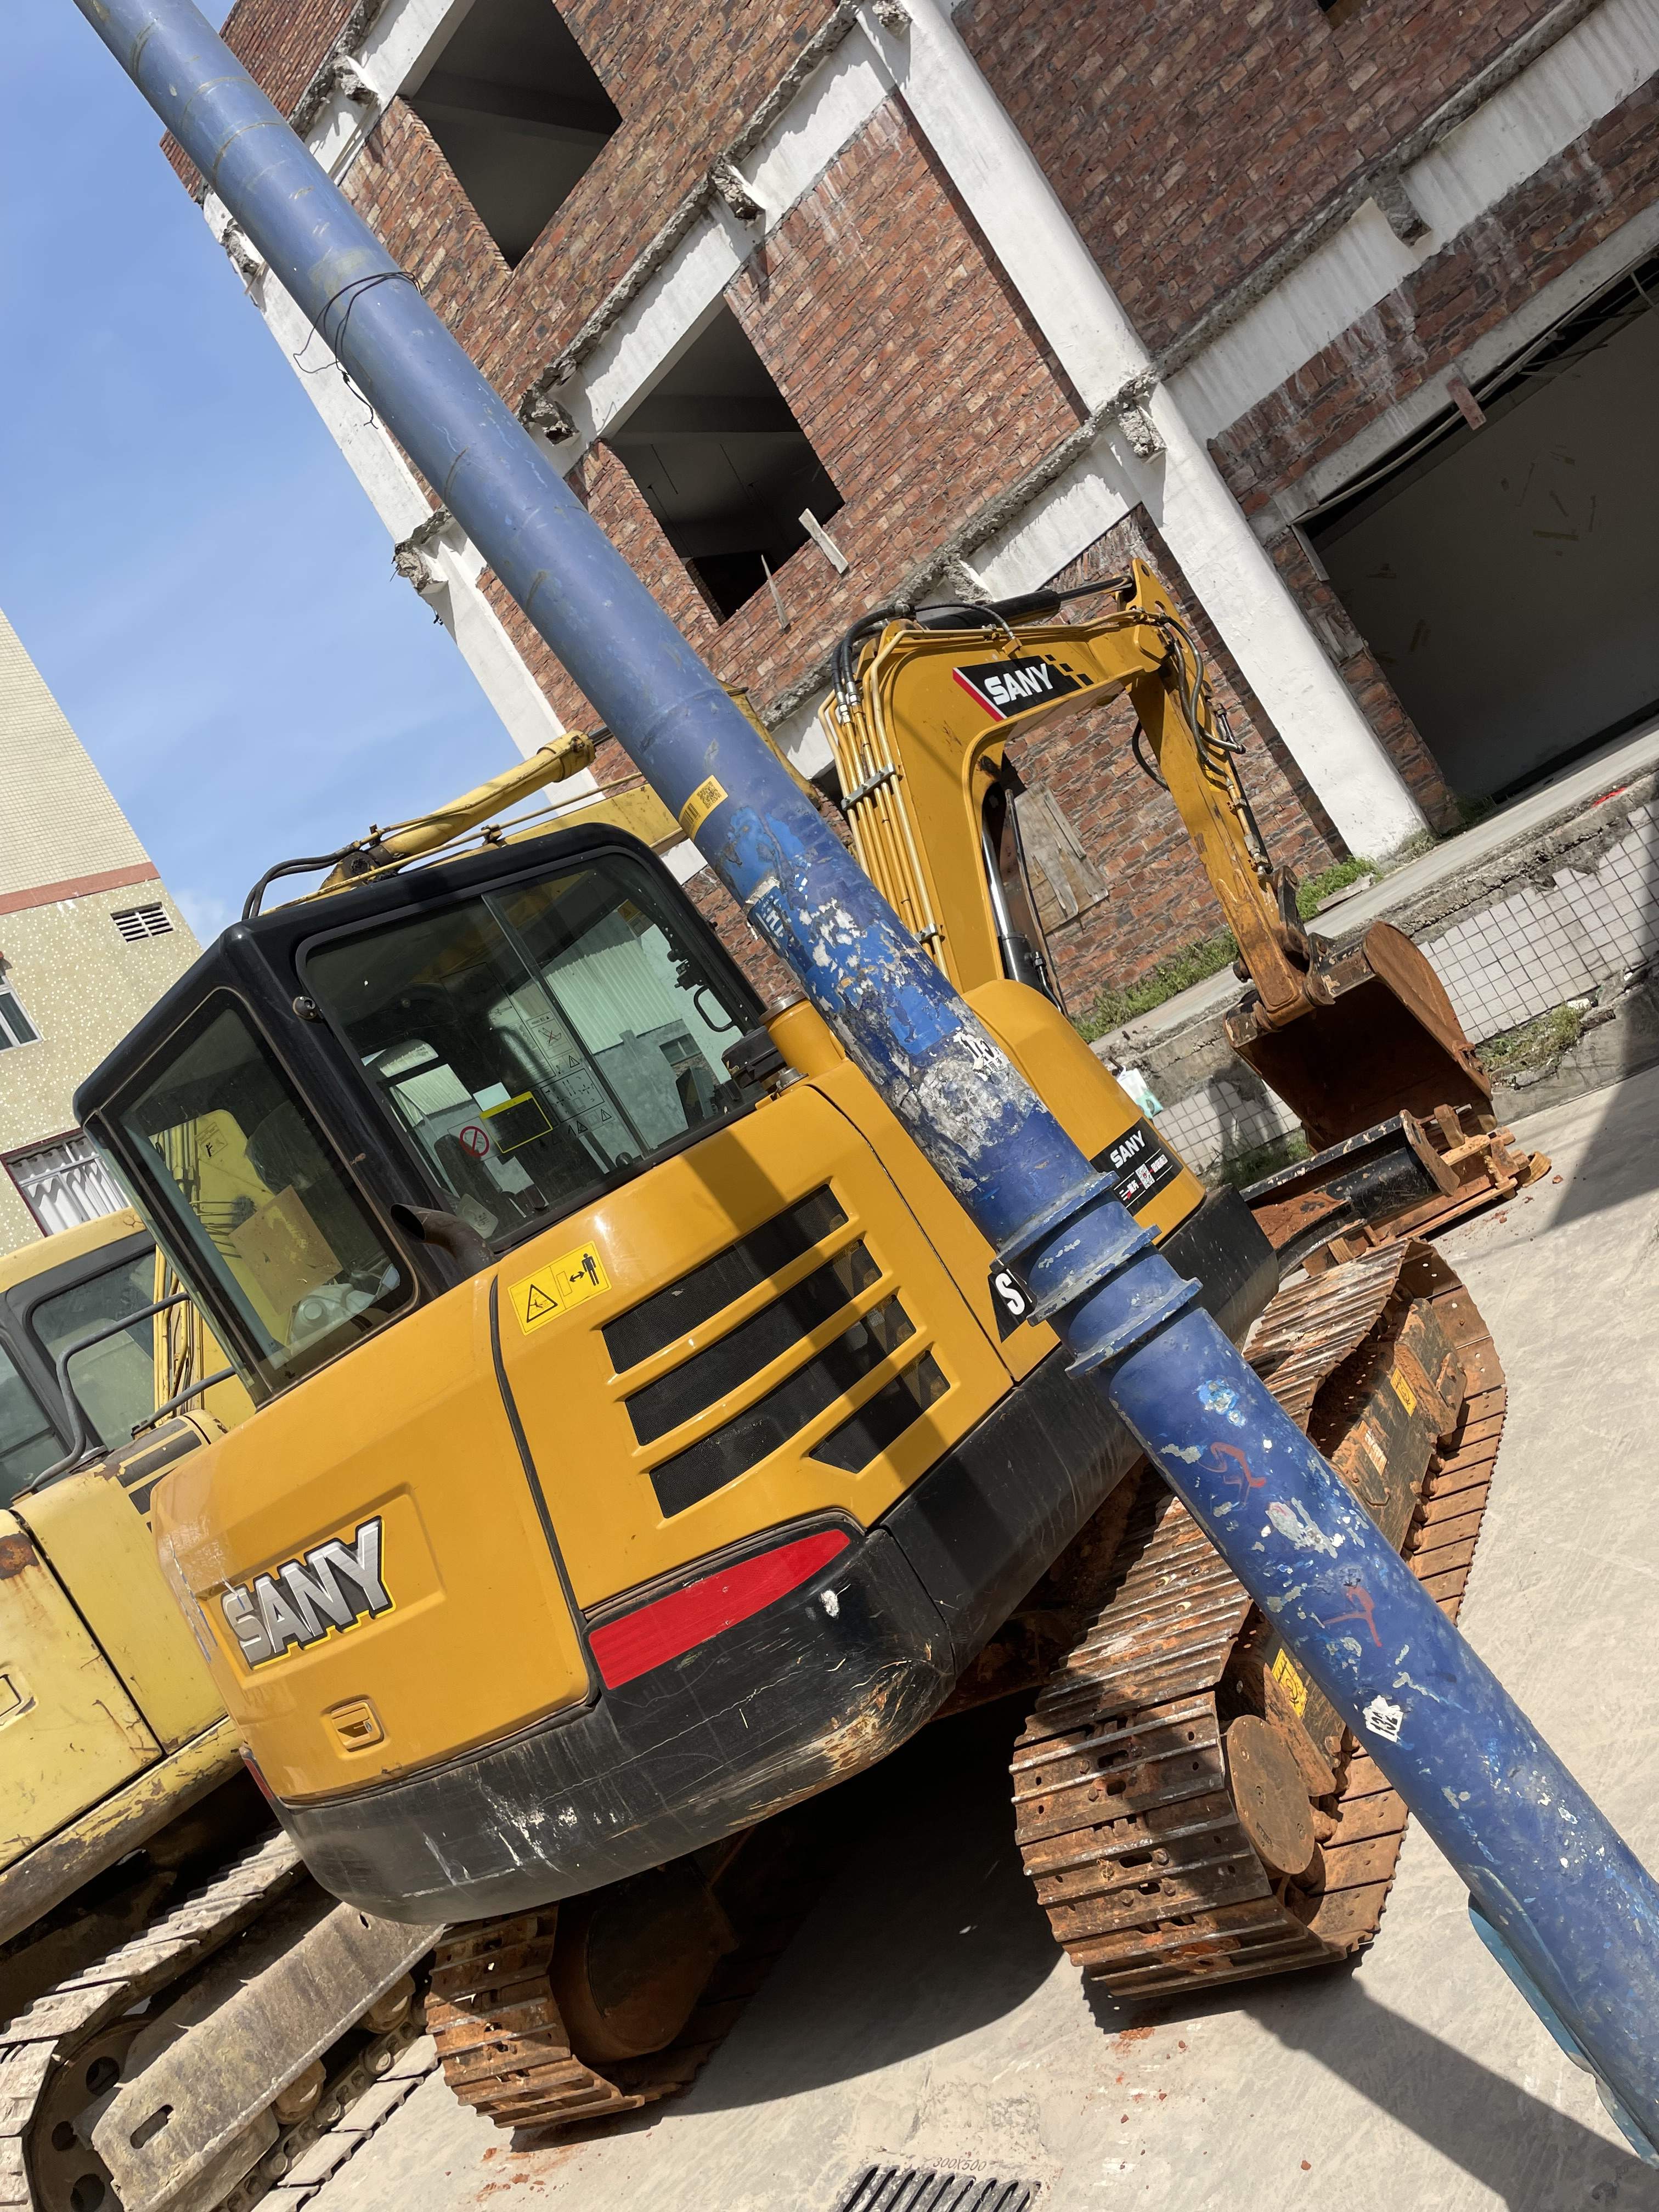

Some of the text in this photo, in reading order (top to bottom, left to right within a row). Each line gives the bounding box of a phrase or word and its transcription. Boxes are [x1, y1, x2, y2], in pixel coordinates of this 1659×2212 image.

[984, 663, 1053, 706] SANY
[1110, 1130, 1146, 1169] SANY
[221, 1516, 395, 1669] SANY
